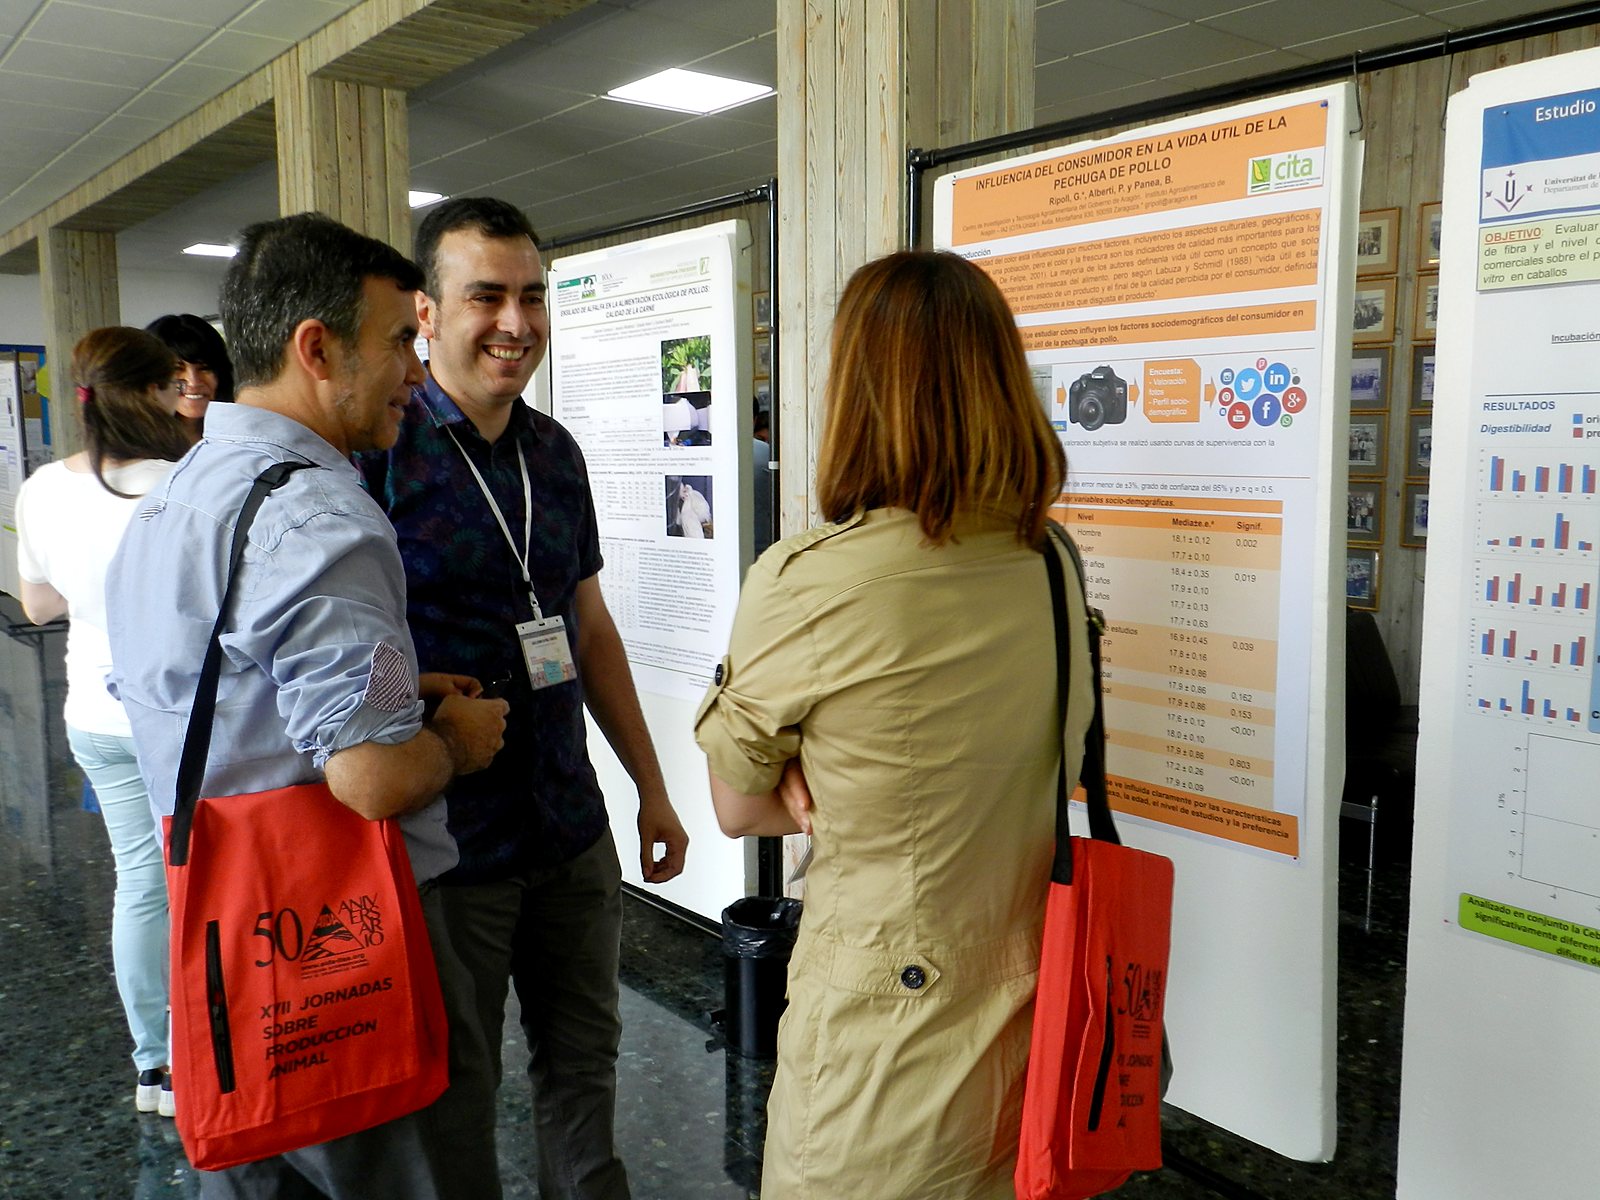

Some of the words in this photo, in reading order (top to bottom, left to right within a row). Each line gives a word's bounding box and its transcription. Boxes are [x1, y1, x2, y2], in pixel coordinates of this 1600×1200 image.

[1535, 99, 1596, 122] Estudio
[976, 170, 1032, 190] INFLUENCIA
[1035, 165, 1054, 178] DEL
[1057, 147, 1132, 172] CONSUMIDOR
[1137, 143, 1153, 156] EN
[1157, 140, 1173, 152] LA
[1178, 133, 1207, 148] VIDA
[1212, 126, 1240, 141] UTIL
[1245, 120, 1264, 135] DE
[1269, 116, 1286, 130] LA
[1054, 170, 1106, 190] PECHUGA
[1110, 166, 1125, 179] DE
[1129, 157, 1171, 175] POLLO
[1275, 154, 1313, 180] cita
[1128, 185, 1132, 193] y
[1184, 226, 1218, 239] aspectos
[1217, 234, 1234, 244] más
[1235, 229, 1282, 243] importantes
[1285, 227, 1305, 238] para
[1556, 224, 1598, 234] Evaluar
[1484, 248, 1497, 256] de
[1504, 244, 1526, 254] fibra
[1533, 244, 1539, 253] y
[1545, 241, 1554, 250] el
[1561, 237, 1588, 247] nivel
[1484, 256, 1544, 270] comerciales
[1546, 254, 1576, 264] sobre
[1580, 251, 1590, 260] el
[1484, 274, 1504, 284] vitro
[1510, 273, 1524, 282] en
[1527, 268, 1568, 280] caballos
[1079, 325, 1106, 335] influyen
[1108, 323, 1119, 332] los
[1120, 321, 1150, 331] factores
[1226, 313, 1239, 322] del
[1240, 310, 1290, 321] consumidor
[1552, 332, 1600, 344] Incubación
[1483, 401, 1555, 411] RESULTADOS
[1480, 424, 1552, 434] Digestibilidad
[1194, 800, 1208, 810] por
[1208, 801, 1220, 812] las
[1180, 805, 1189, 815] de
[1191, 810, 1224, 823] estudios
[1232, 817, 1240, 827] la
[1242, 822, 1289, 838] preferencia
[1468, 897, 1511, 914] Analizado
[1513, 911, 1524, 919] en
[1527, 915, 1569, 931] conjunto
[1571, 924, 1580, 934] la
[1475, 912, 1557, 941] significativamente
[253, 907, 303, 968] 50
[260, 1000, 290, 1019] XVII
[300, 978, 393, 1011] JORNADAS
[263, 1015, 319, 1040] SOBRE
[266, 1020, 378, 1060] PRODUCCIÓN
[268, 1052, 330, 1081] ANIMAL
